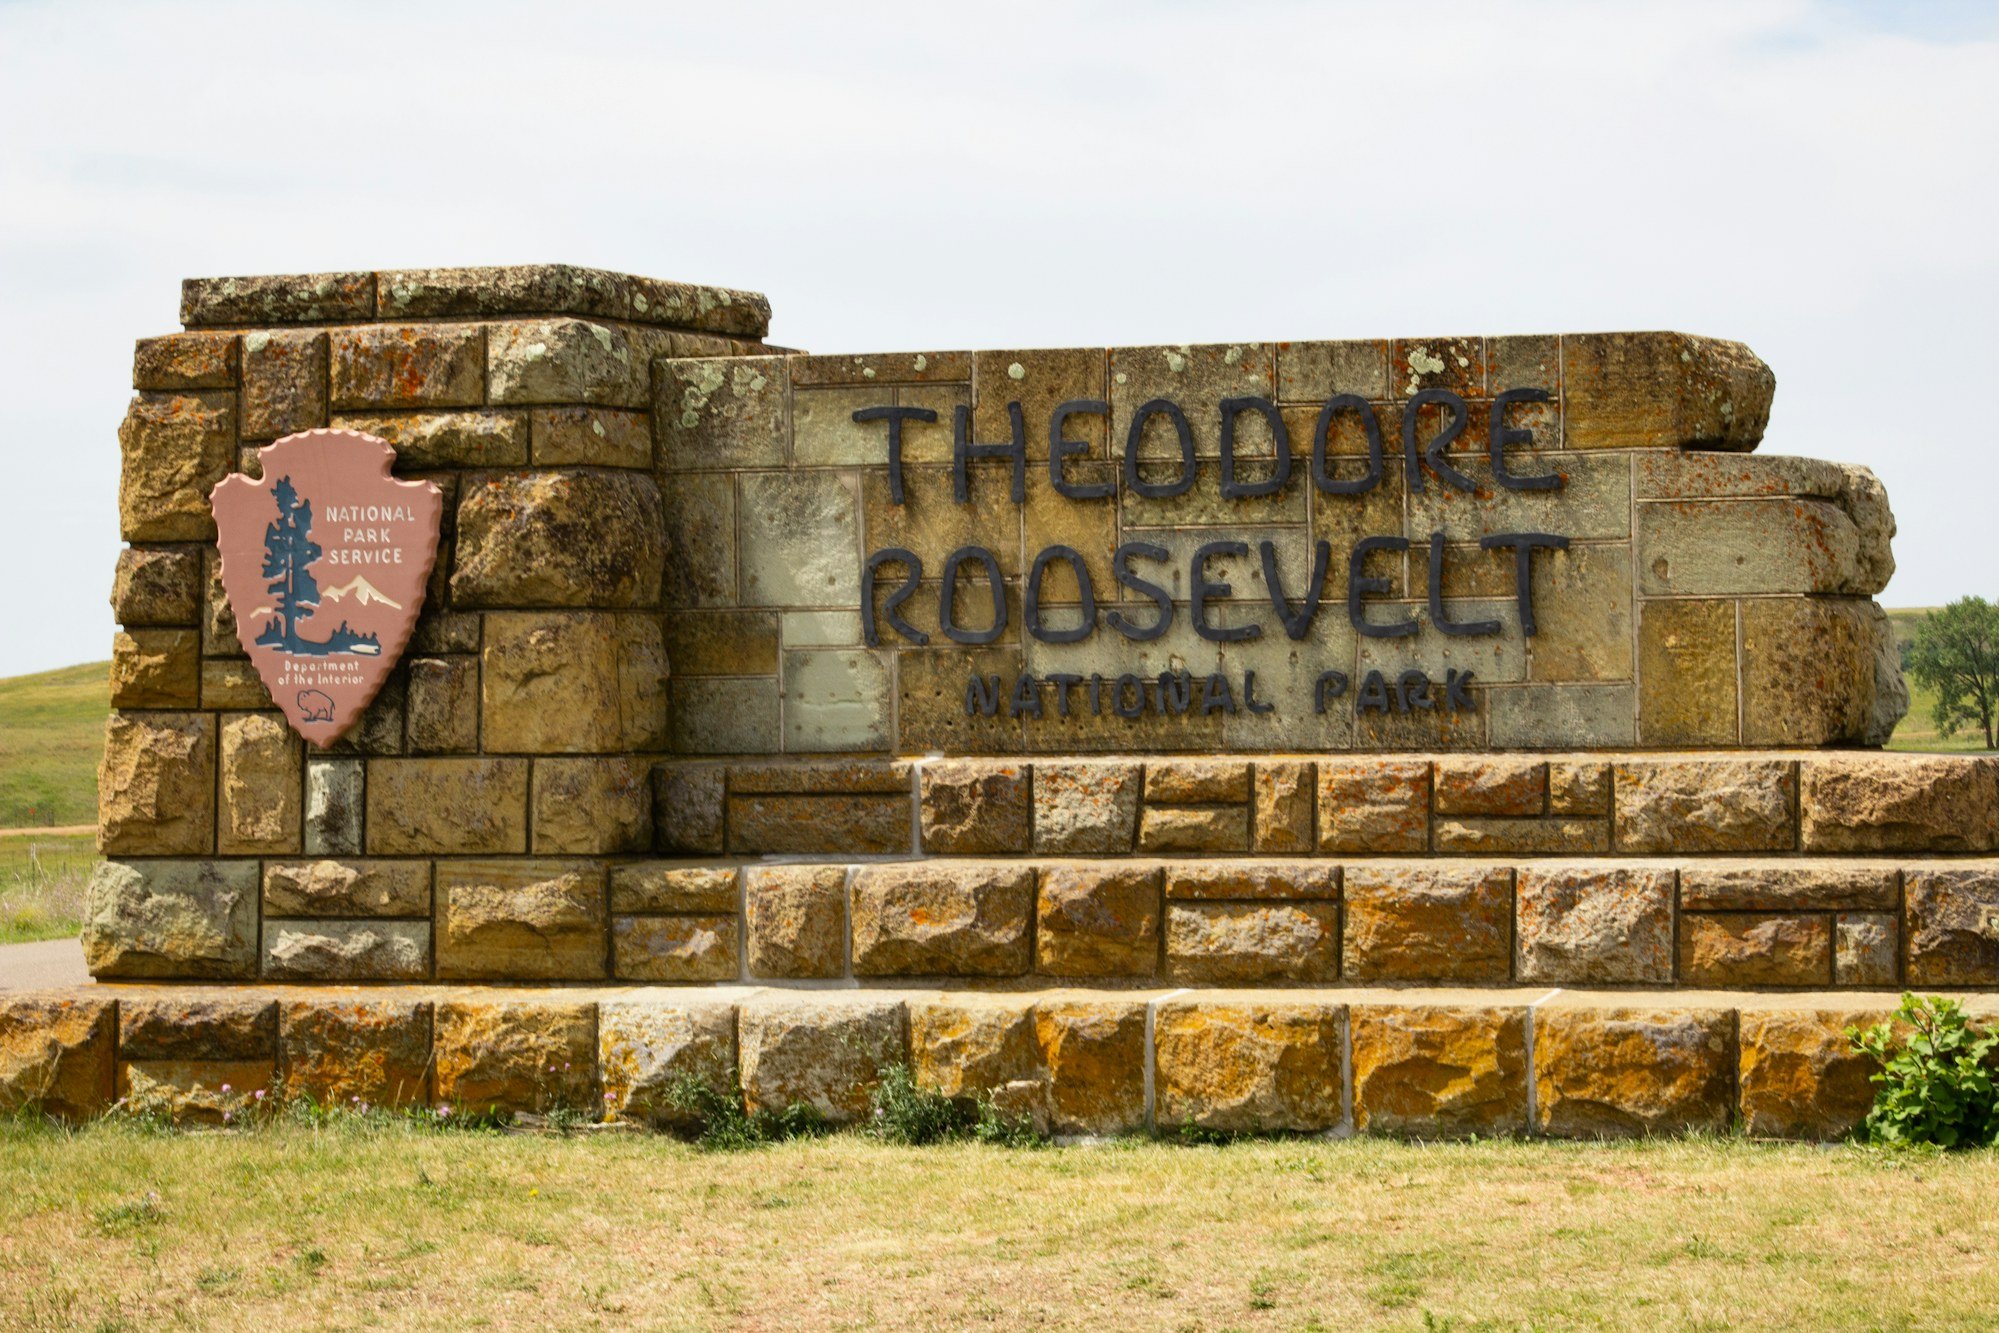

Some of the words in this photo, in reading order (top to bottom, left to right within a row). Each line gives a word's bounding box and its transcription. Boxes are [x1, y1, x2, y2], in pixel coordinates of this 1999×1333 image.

[852, 388, 1564, 504] THEODORE
[326, 505, 415, 522] NATIONAL
[344, 527, 391, 543] PARK
[329, 548, 402, 565] SERVICE
[861, 533, 1570, 647] ROOSEVELT
[284, 660, 360, 674] Department
[278, 673, 291, 686] of
[293, 673, 314, 686] the
[317, 673, 365, 686] Interior
[965, 670, 1274, 720] NATIONAL
[1314, 668, 1477, 716] PARK
